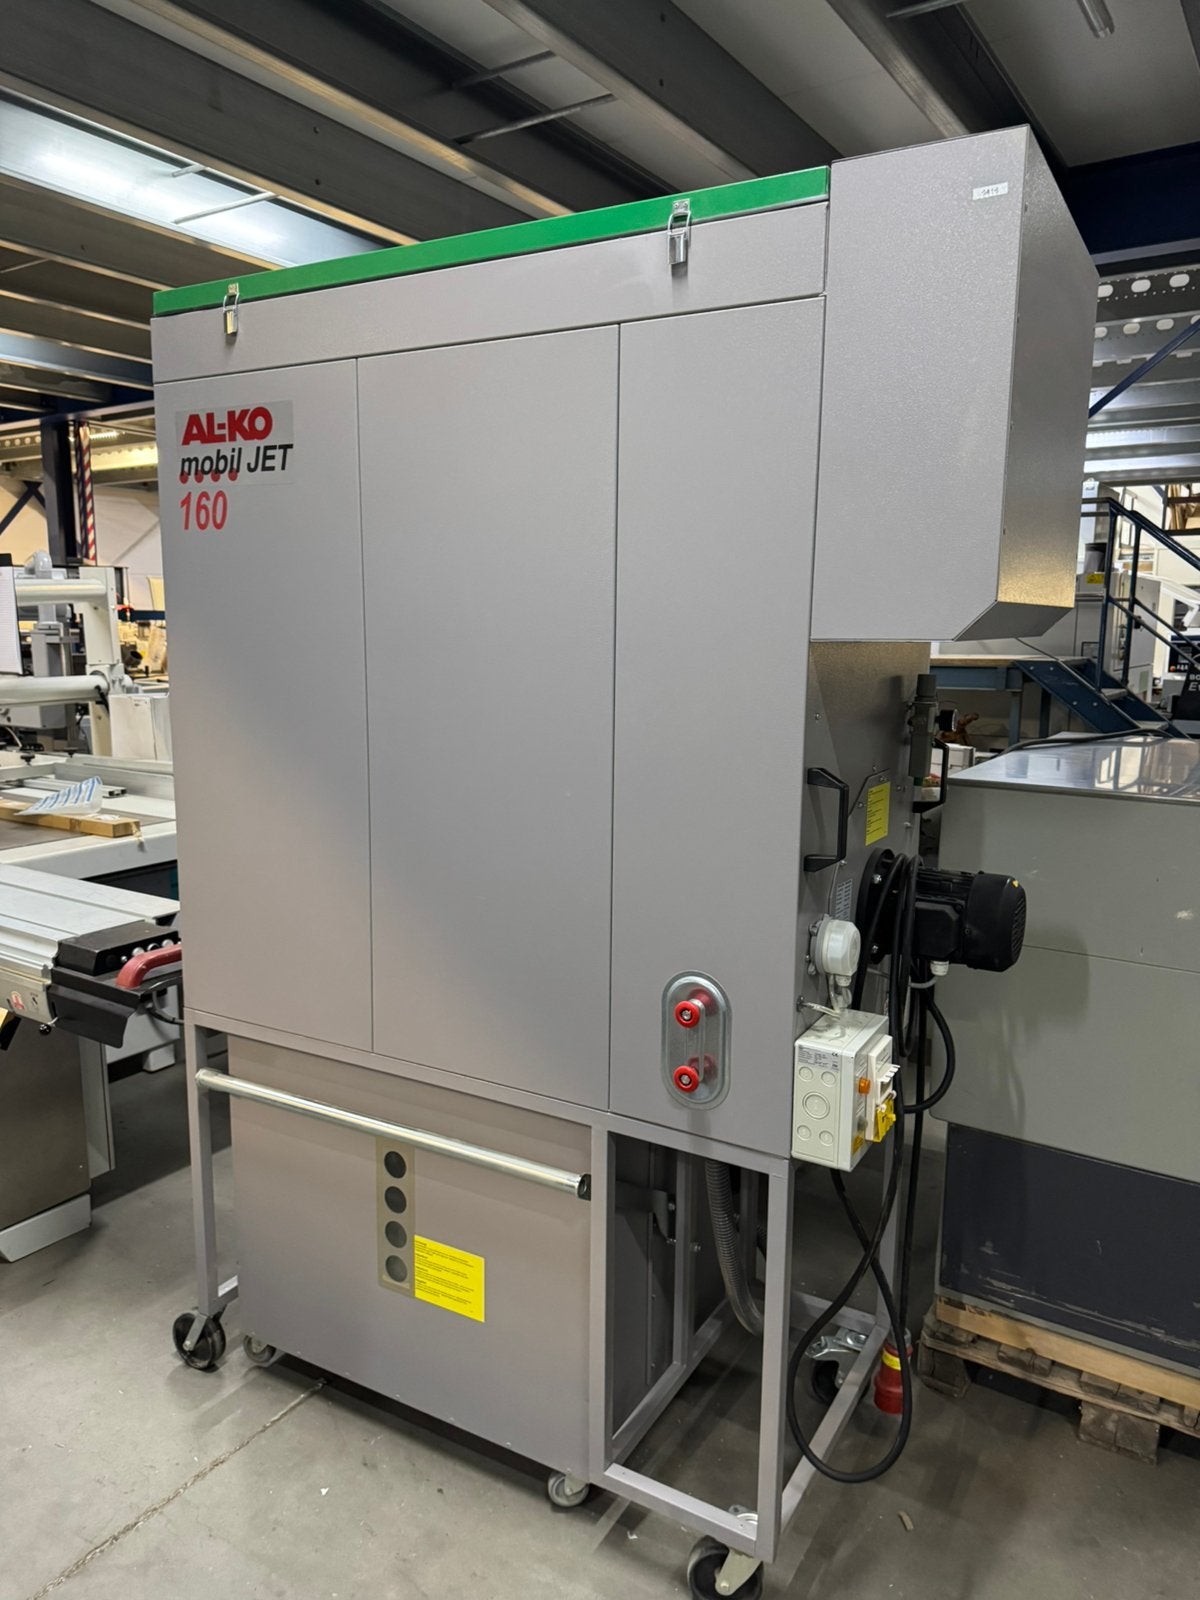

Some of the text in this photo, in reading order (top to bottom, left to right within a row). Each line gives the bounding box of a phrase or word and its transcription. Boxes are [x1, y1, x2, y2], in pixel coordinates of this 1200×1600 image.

[182, 406, 273, 445] AL-KO
[180, 443, 294, 477] mobil JET
[180, 490, 228, 531] 160
